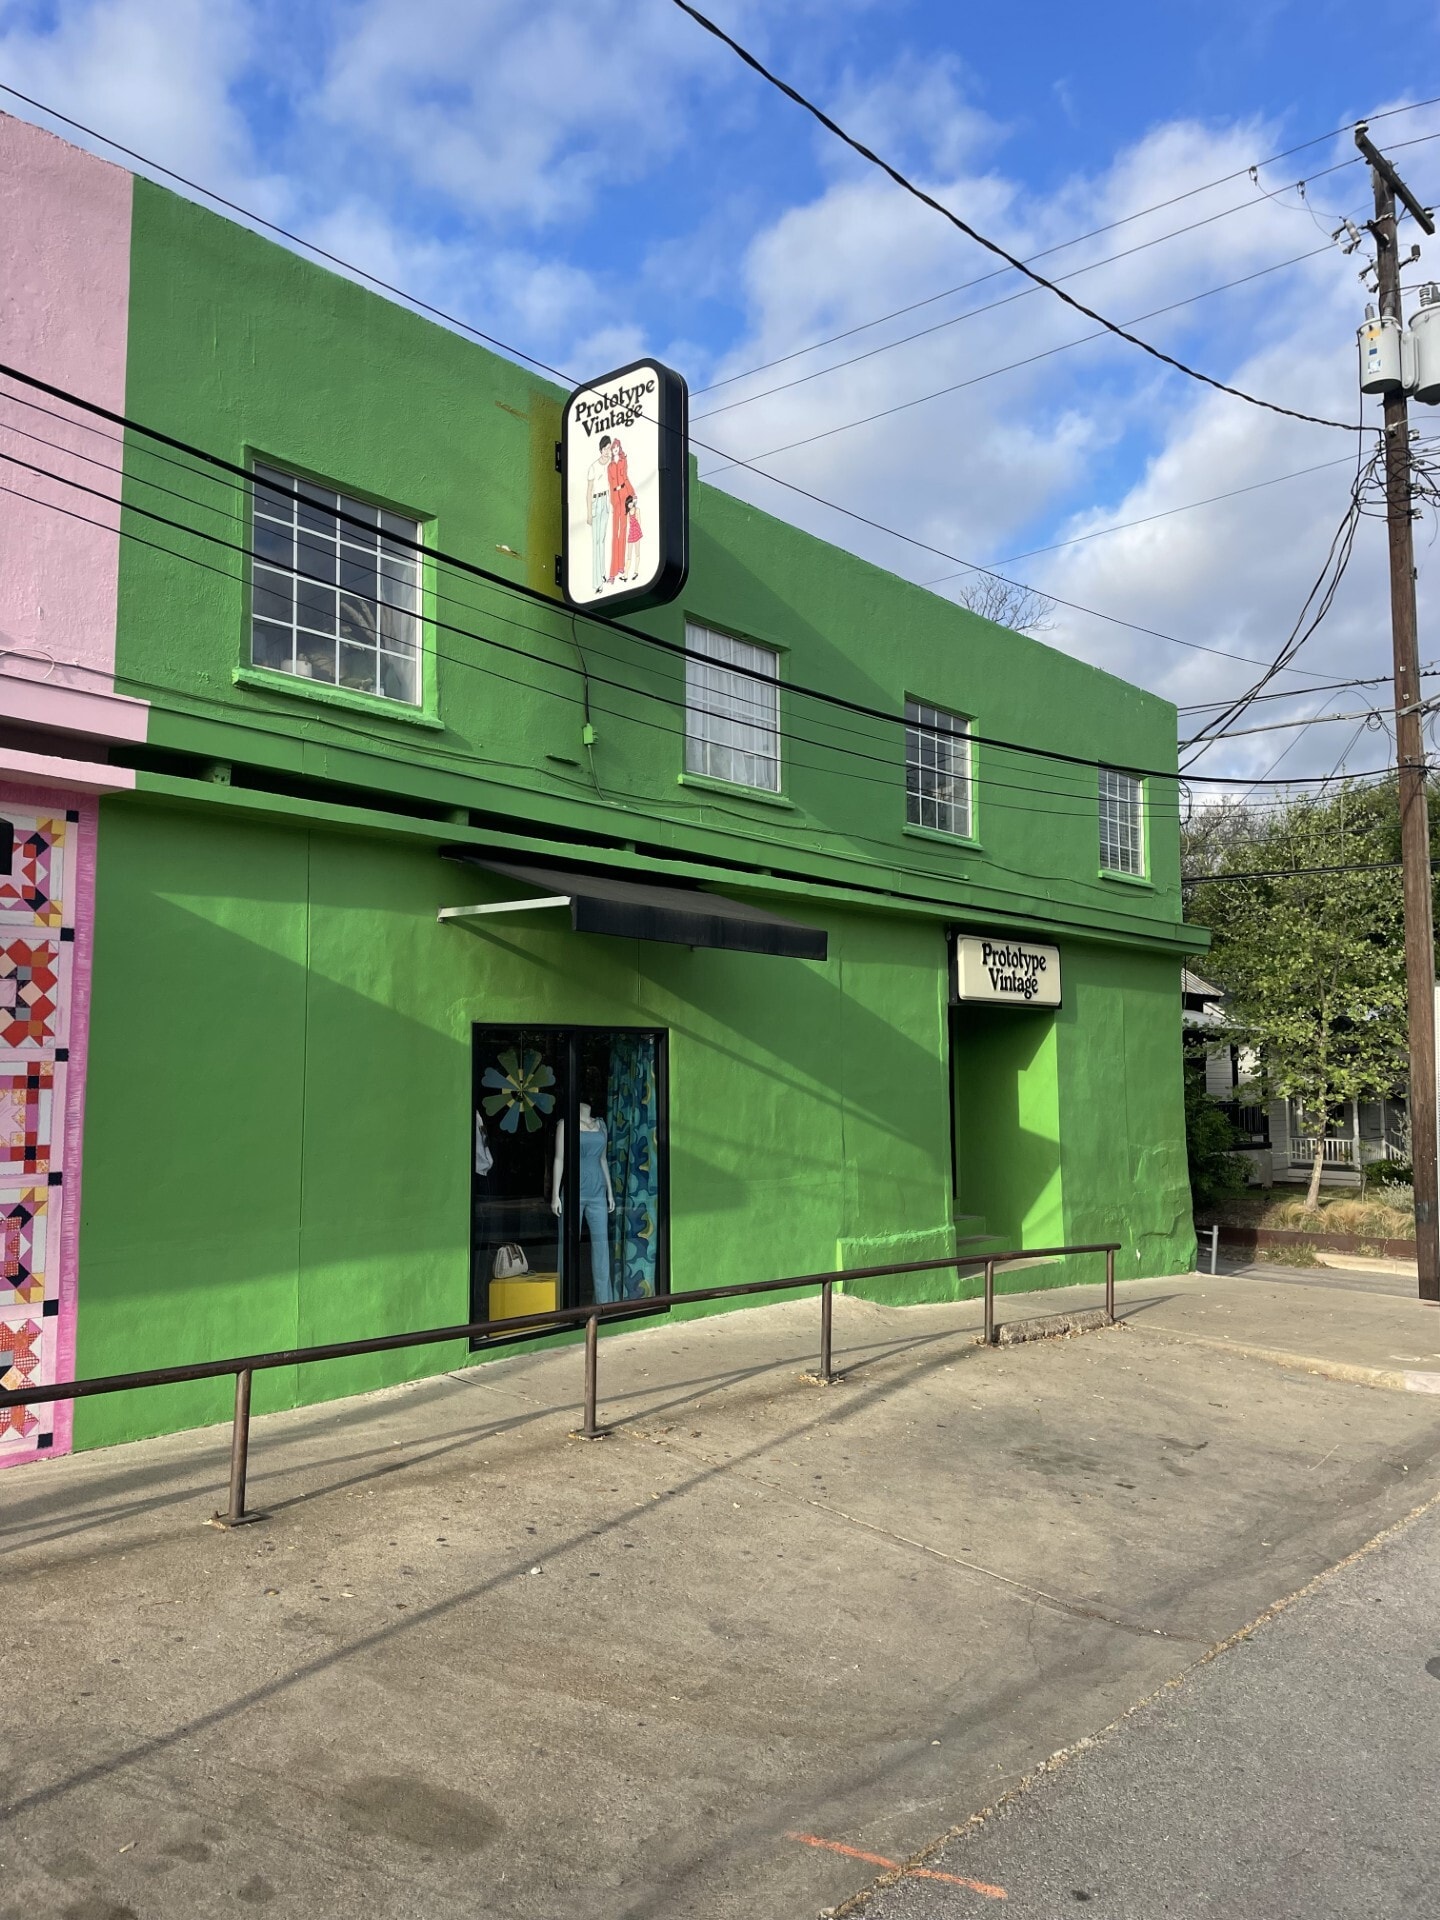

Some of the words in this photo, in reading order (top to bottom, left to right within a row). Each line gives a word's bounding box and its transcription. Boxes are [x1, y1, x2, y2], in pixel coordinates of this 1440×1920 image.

[575, 380, 655, 422] Prototype
[582, 404, 643, 437] Vintage
[982, 943, 1046, 976] Prototype
[988, 967, 1038, 999] Vintage
